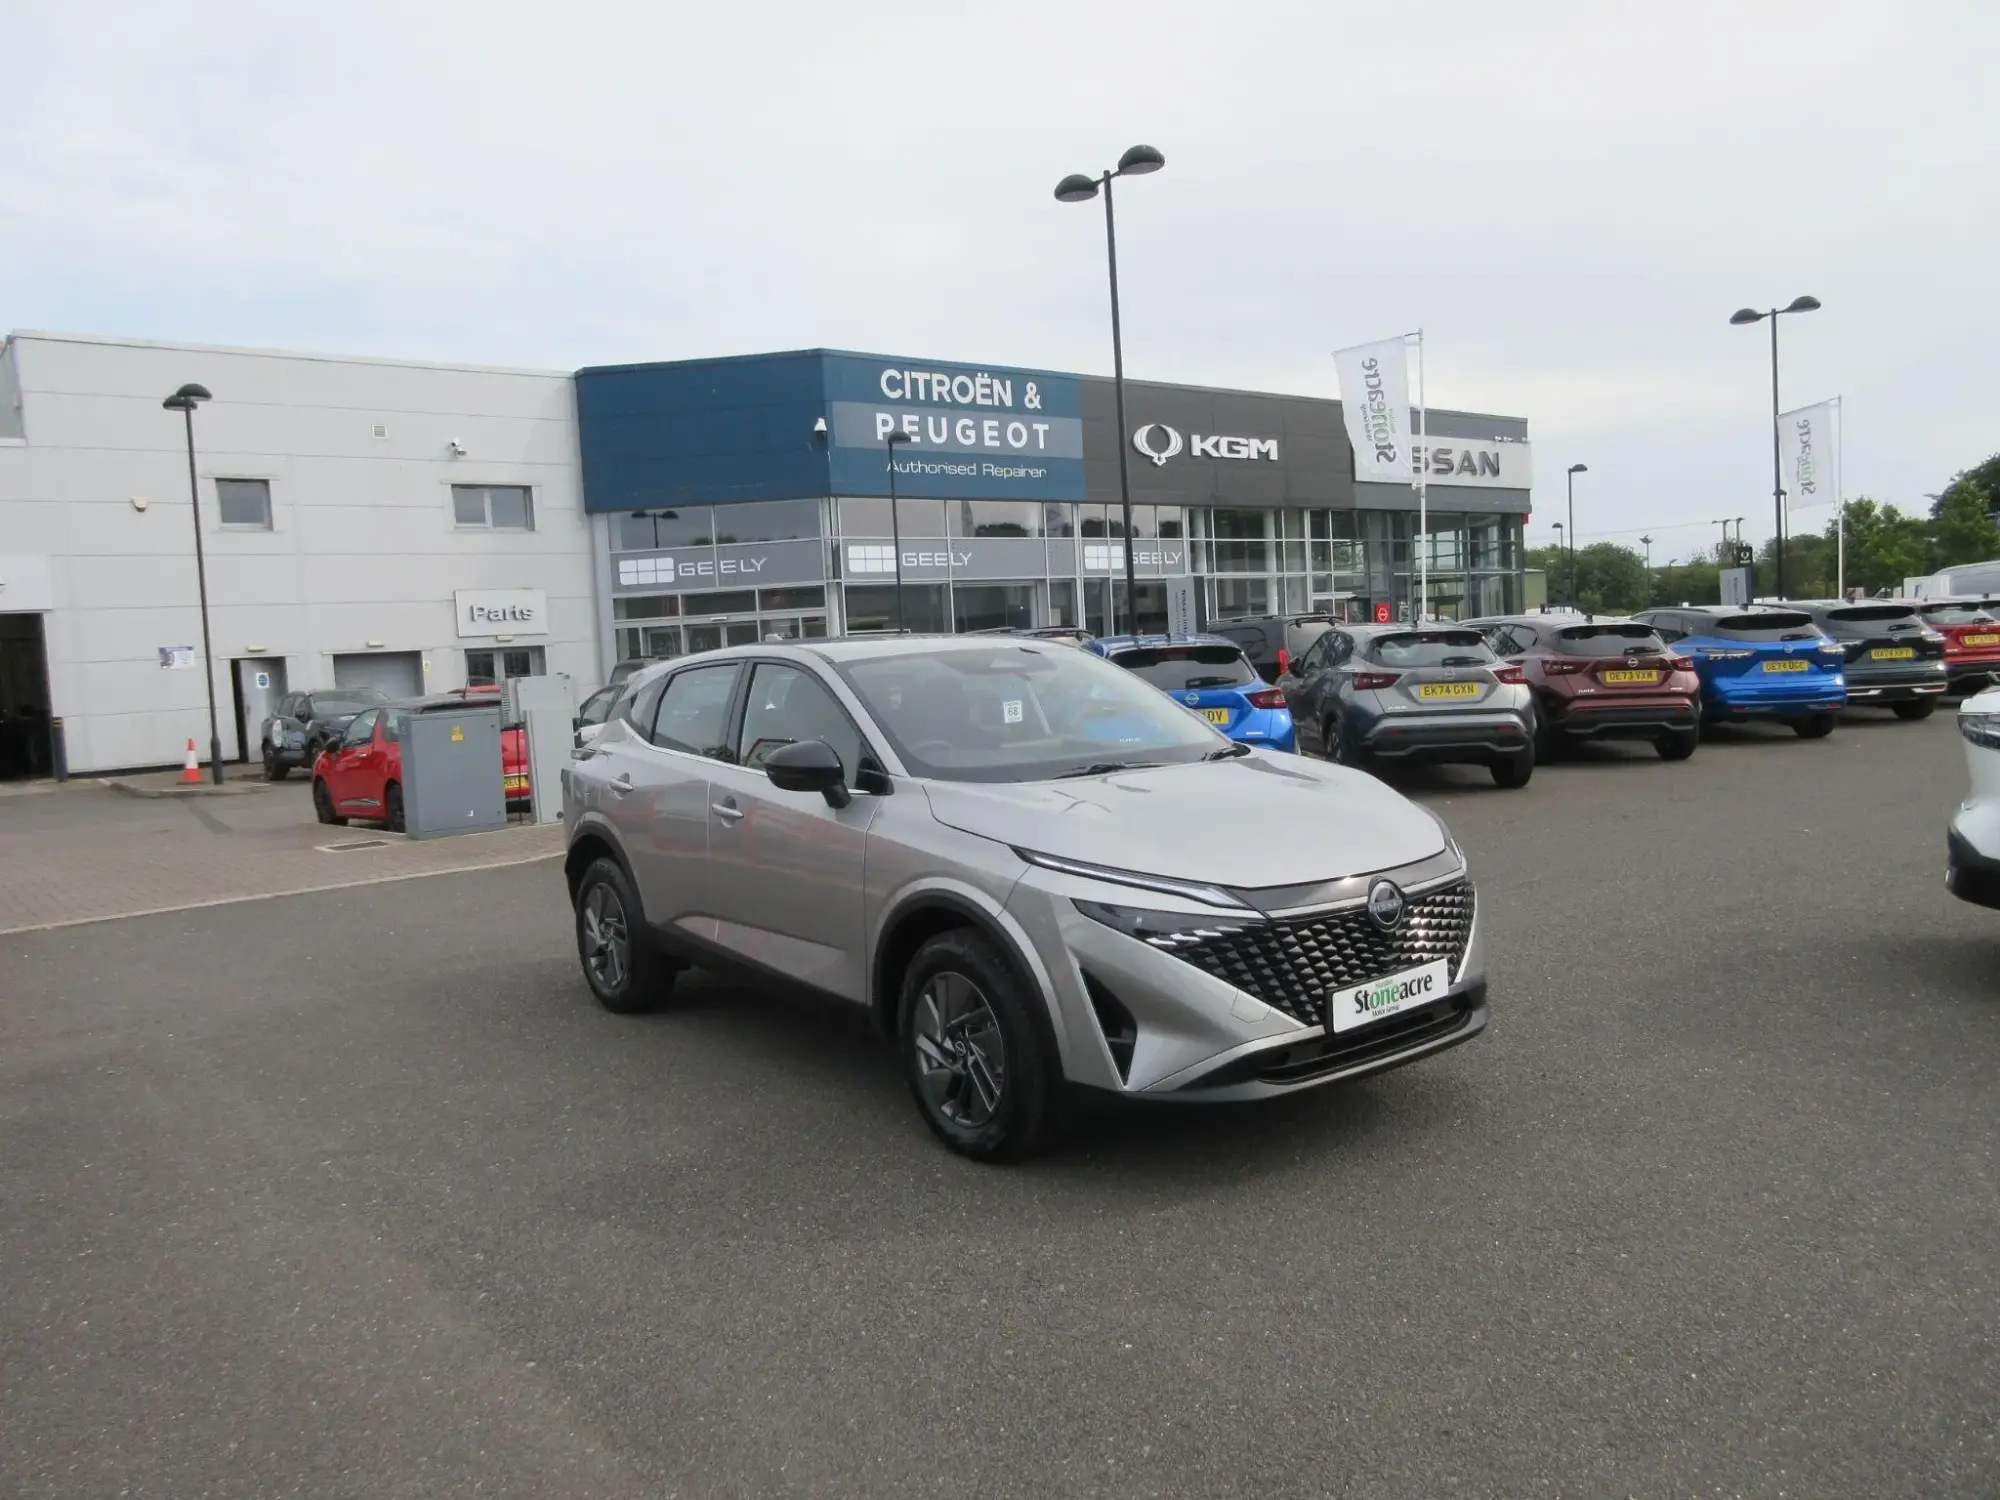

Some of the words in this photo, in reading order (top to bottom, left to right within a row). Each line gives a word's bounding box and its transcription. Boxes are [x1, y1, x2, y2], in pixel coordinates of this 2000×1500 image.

[880, 368, 1013, 407] CITROËN
[1024, 382, 1042, 409] &
[876, 412, 1049, 449] PEUGEOT
[1190, 434, 1278, 461] KGM
[887, 460, 976, 476] Authorised
[982, 463, 1046, 480] Repairer
[1411, 446, 1500, 477] SSAN
[678, 557, 769, 576] GEELY
[902, 552, 973, 567] GEELY
[470, 605, 534, 622] Parts
[1424, 685, 1451, 696] EK74
[1454, 684, 1475, 694] GXN
[1354, 974, 1432, 1014] Stoneacre
